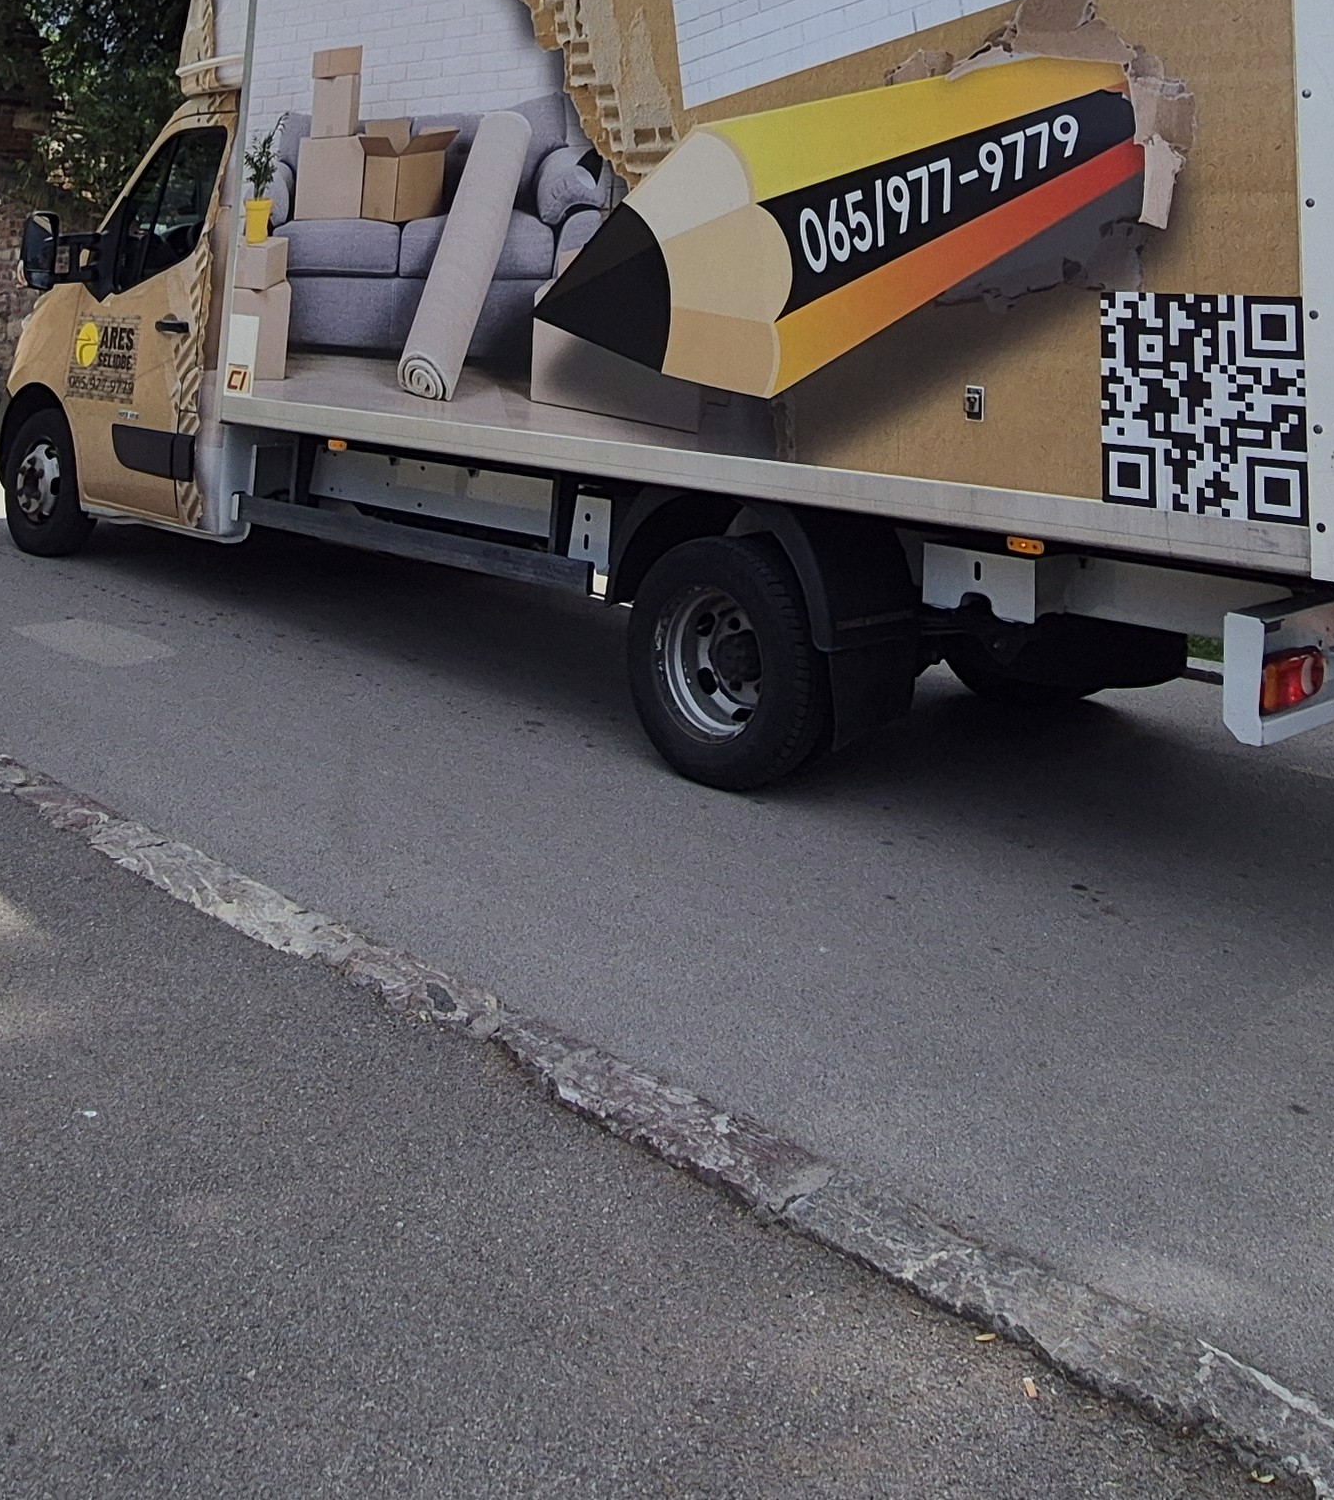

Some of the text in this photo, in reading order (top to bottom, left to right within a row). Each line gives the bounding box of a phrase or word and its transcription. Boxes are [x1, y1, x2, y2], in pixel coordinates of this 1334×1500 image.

[799, 114, 1080, 274] 065/977-9779
[99, 326, 135, 351] ARES
[97, 352, 134, 371] SELIDBE
